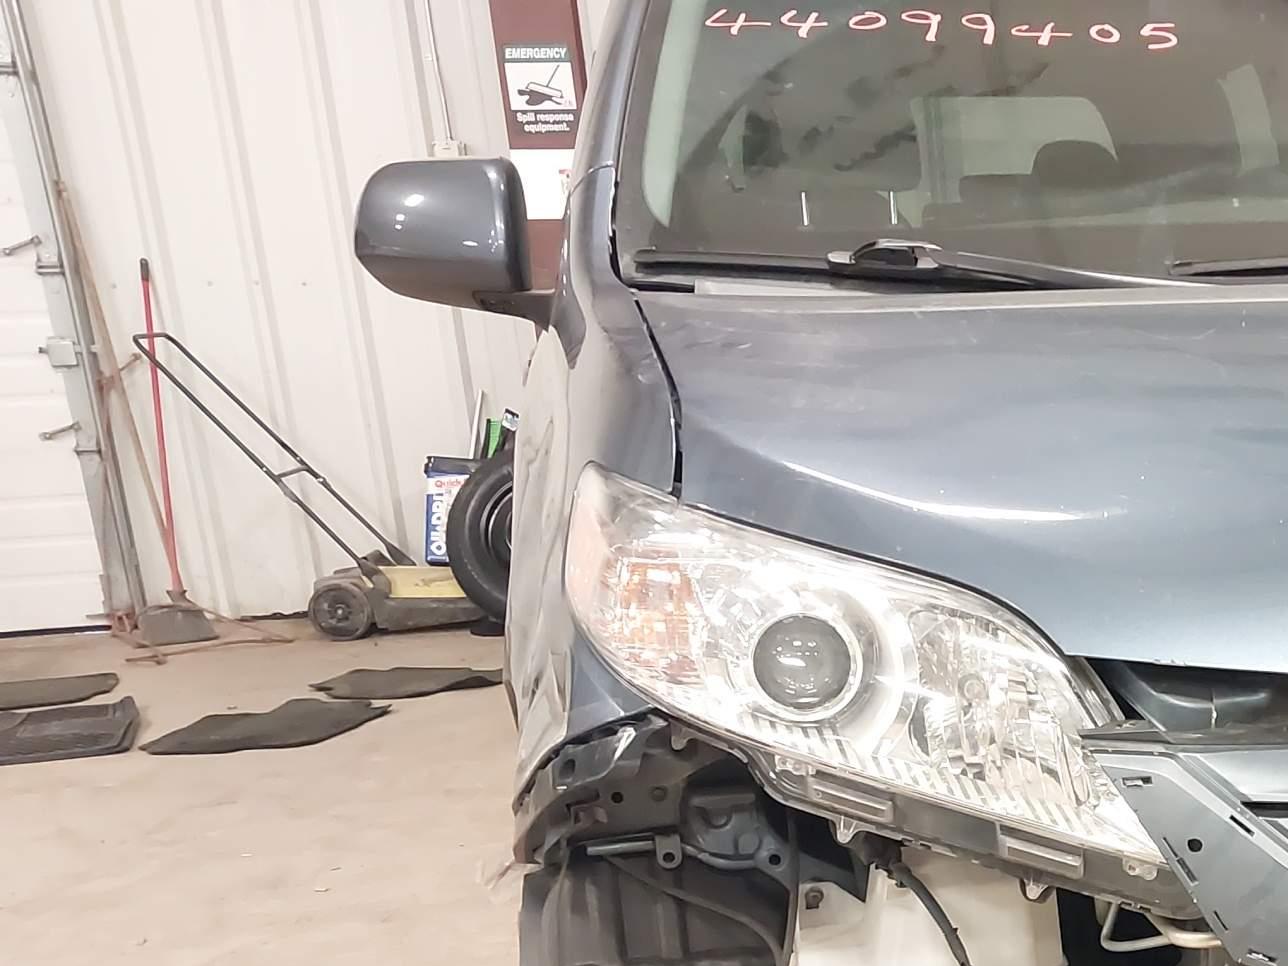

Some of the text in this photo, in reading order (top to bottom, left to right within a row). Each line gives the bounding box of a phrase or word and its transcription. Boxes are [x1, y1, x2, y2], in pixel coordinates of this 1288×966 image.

[704, 9, 1179, 49] 44099405
[505, 48, 567, 59] EMERGENCY
[517, 112, 574, 122] Spill response
